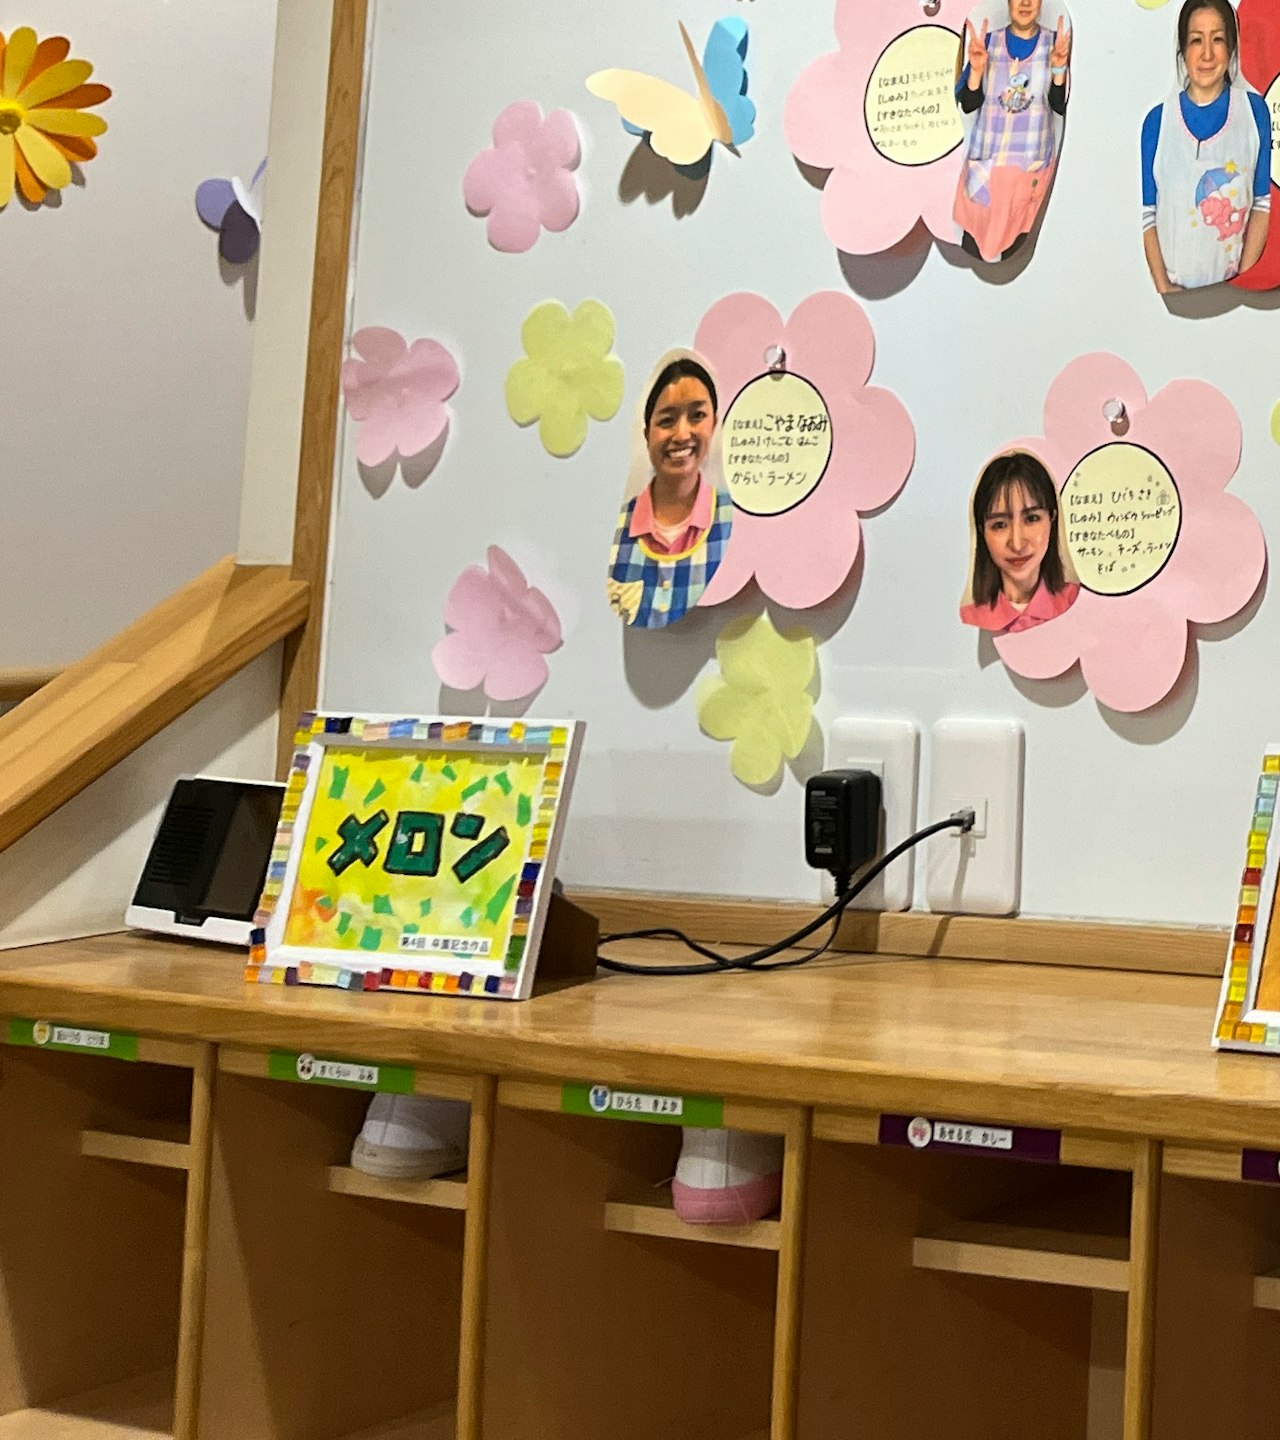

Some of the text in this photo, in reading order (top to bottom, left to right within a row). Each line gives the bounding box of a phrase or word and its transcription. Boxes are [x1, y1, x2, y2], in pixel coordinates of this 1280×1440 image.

[767, 470, 807, 486] ラーメン
[329, 808, 512, 885] メロン
